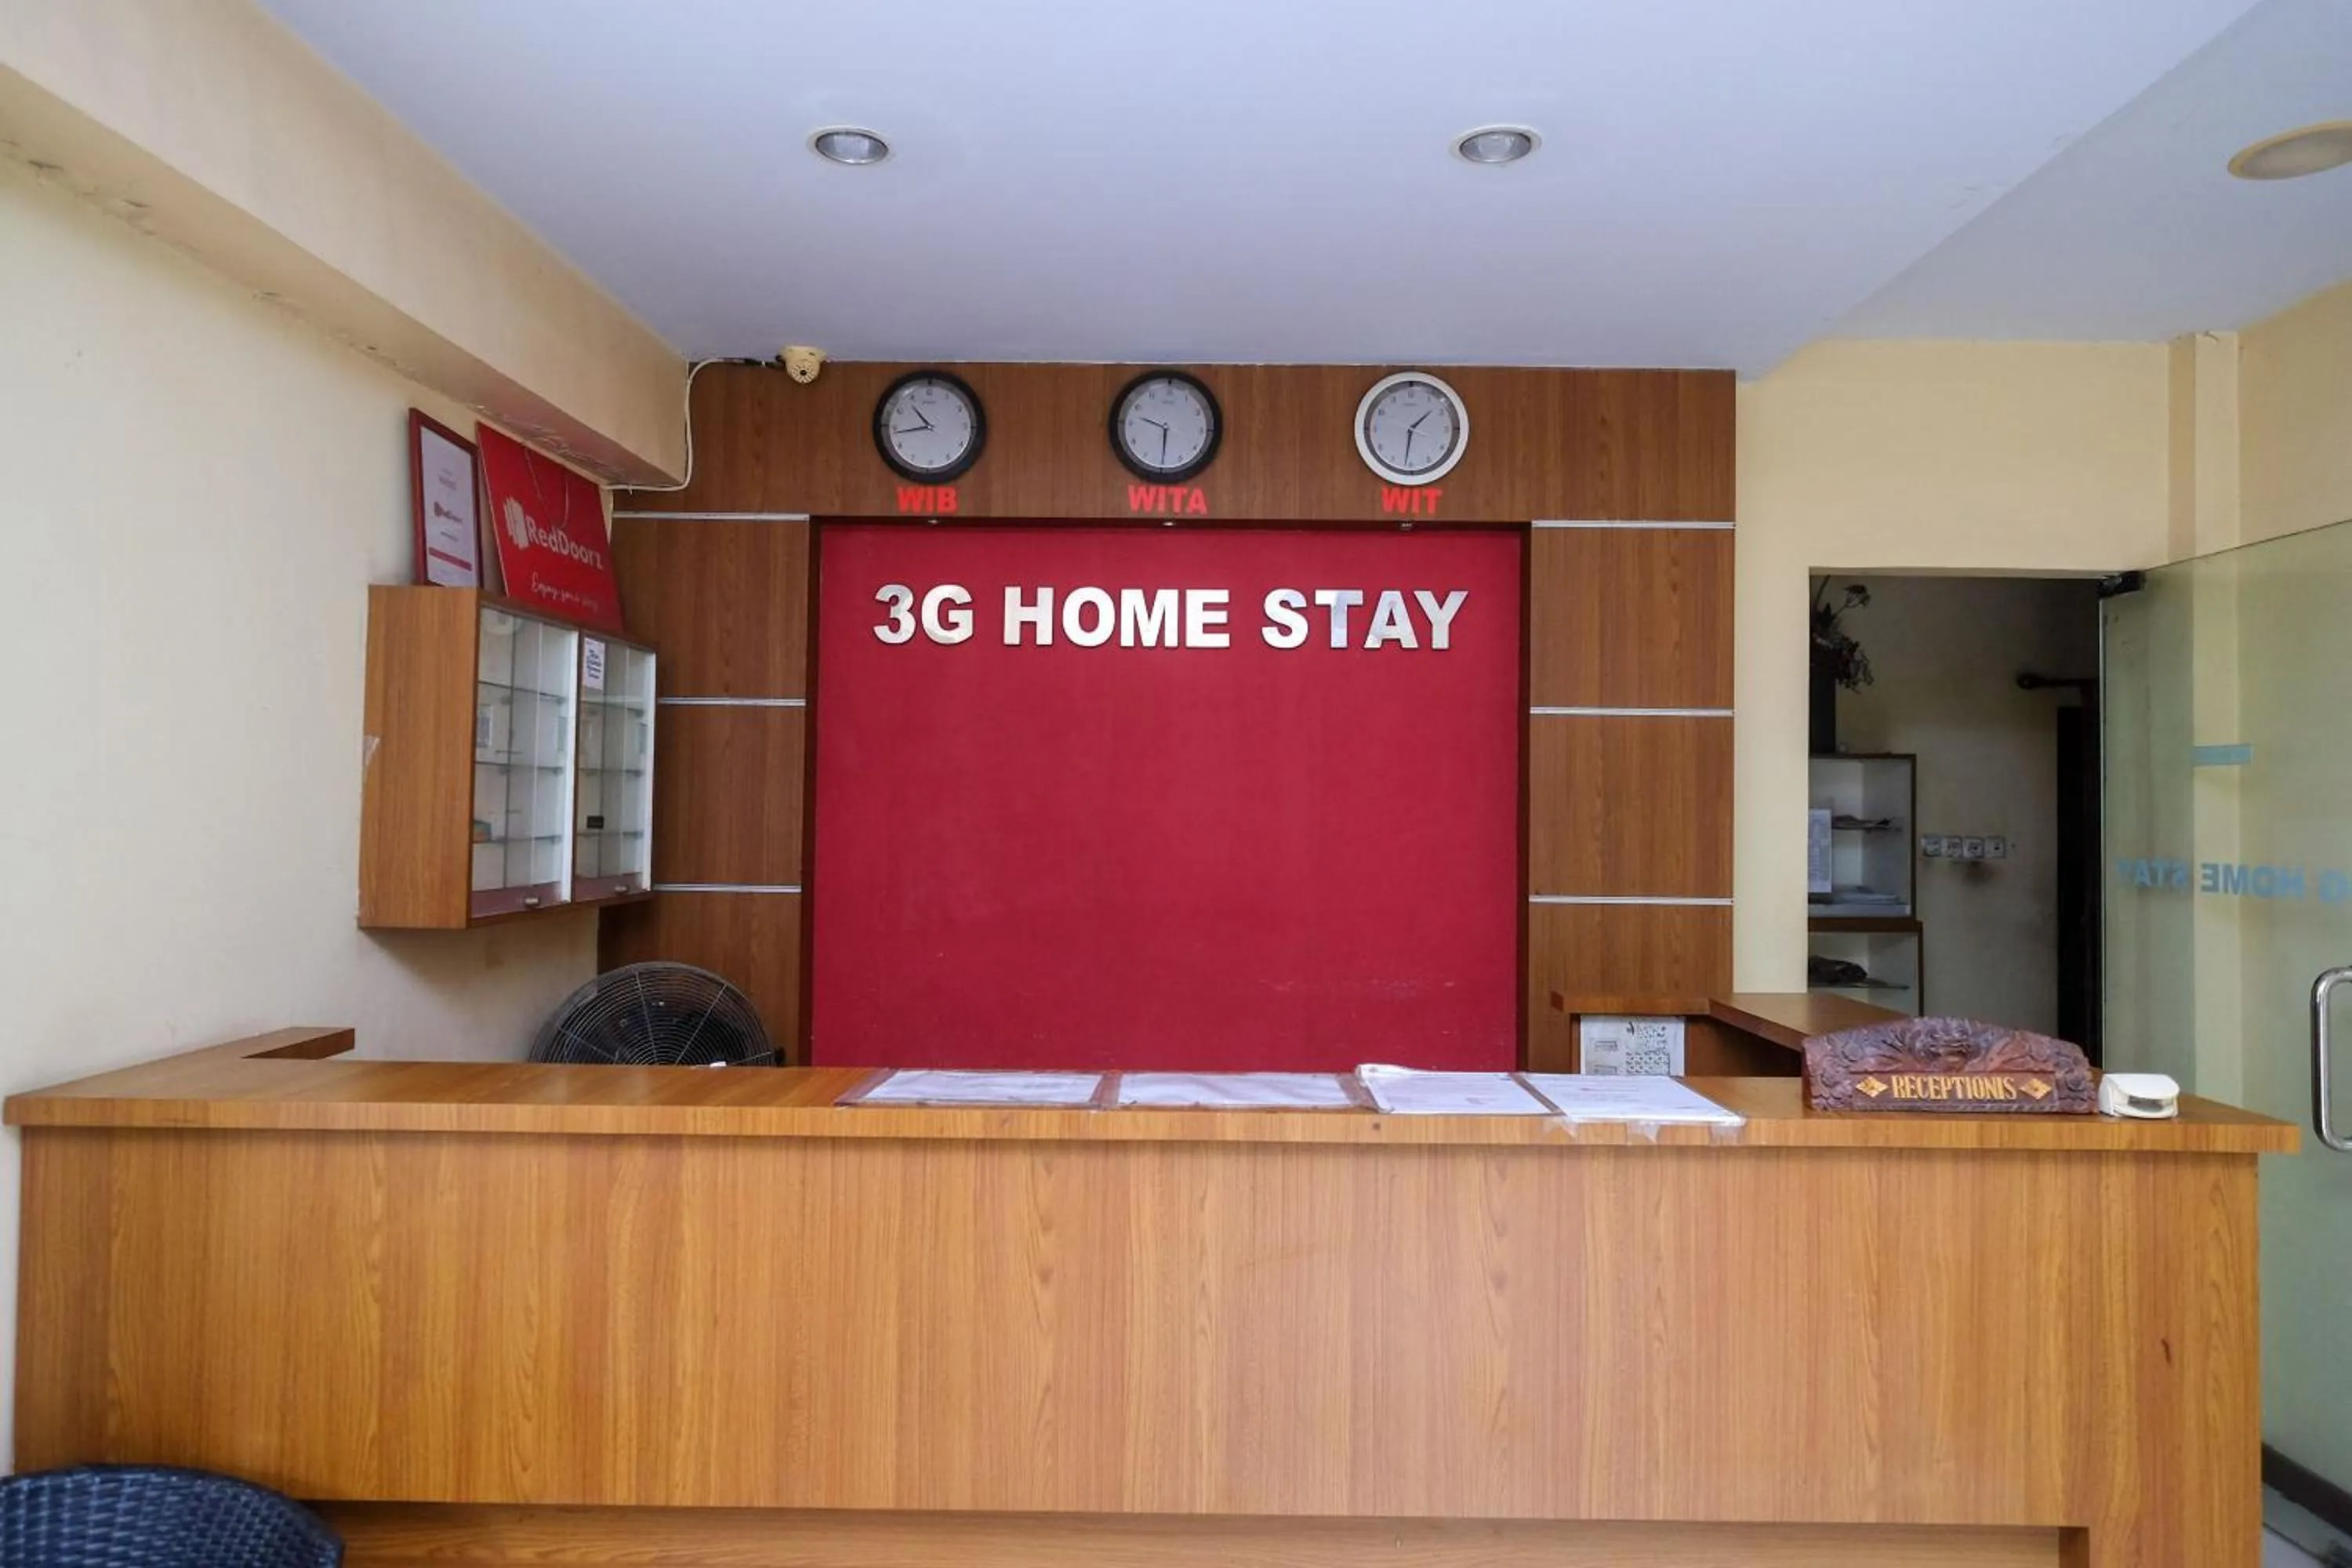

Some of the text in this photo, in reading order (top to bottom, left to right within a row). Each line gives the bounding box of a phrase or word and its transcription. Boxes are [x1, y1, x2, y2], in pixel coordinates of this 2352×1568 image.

[897, 486, 958, 514] WIB
[1127, 485, 1208, 514] WITA
[1381, 486, 1443, 514] WIT
[873, 584, 1468, 649] 3G HOME STAY
[1891, 1075, 2017, 1100] RECEPTIONIS
